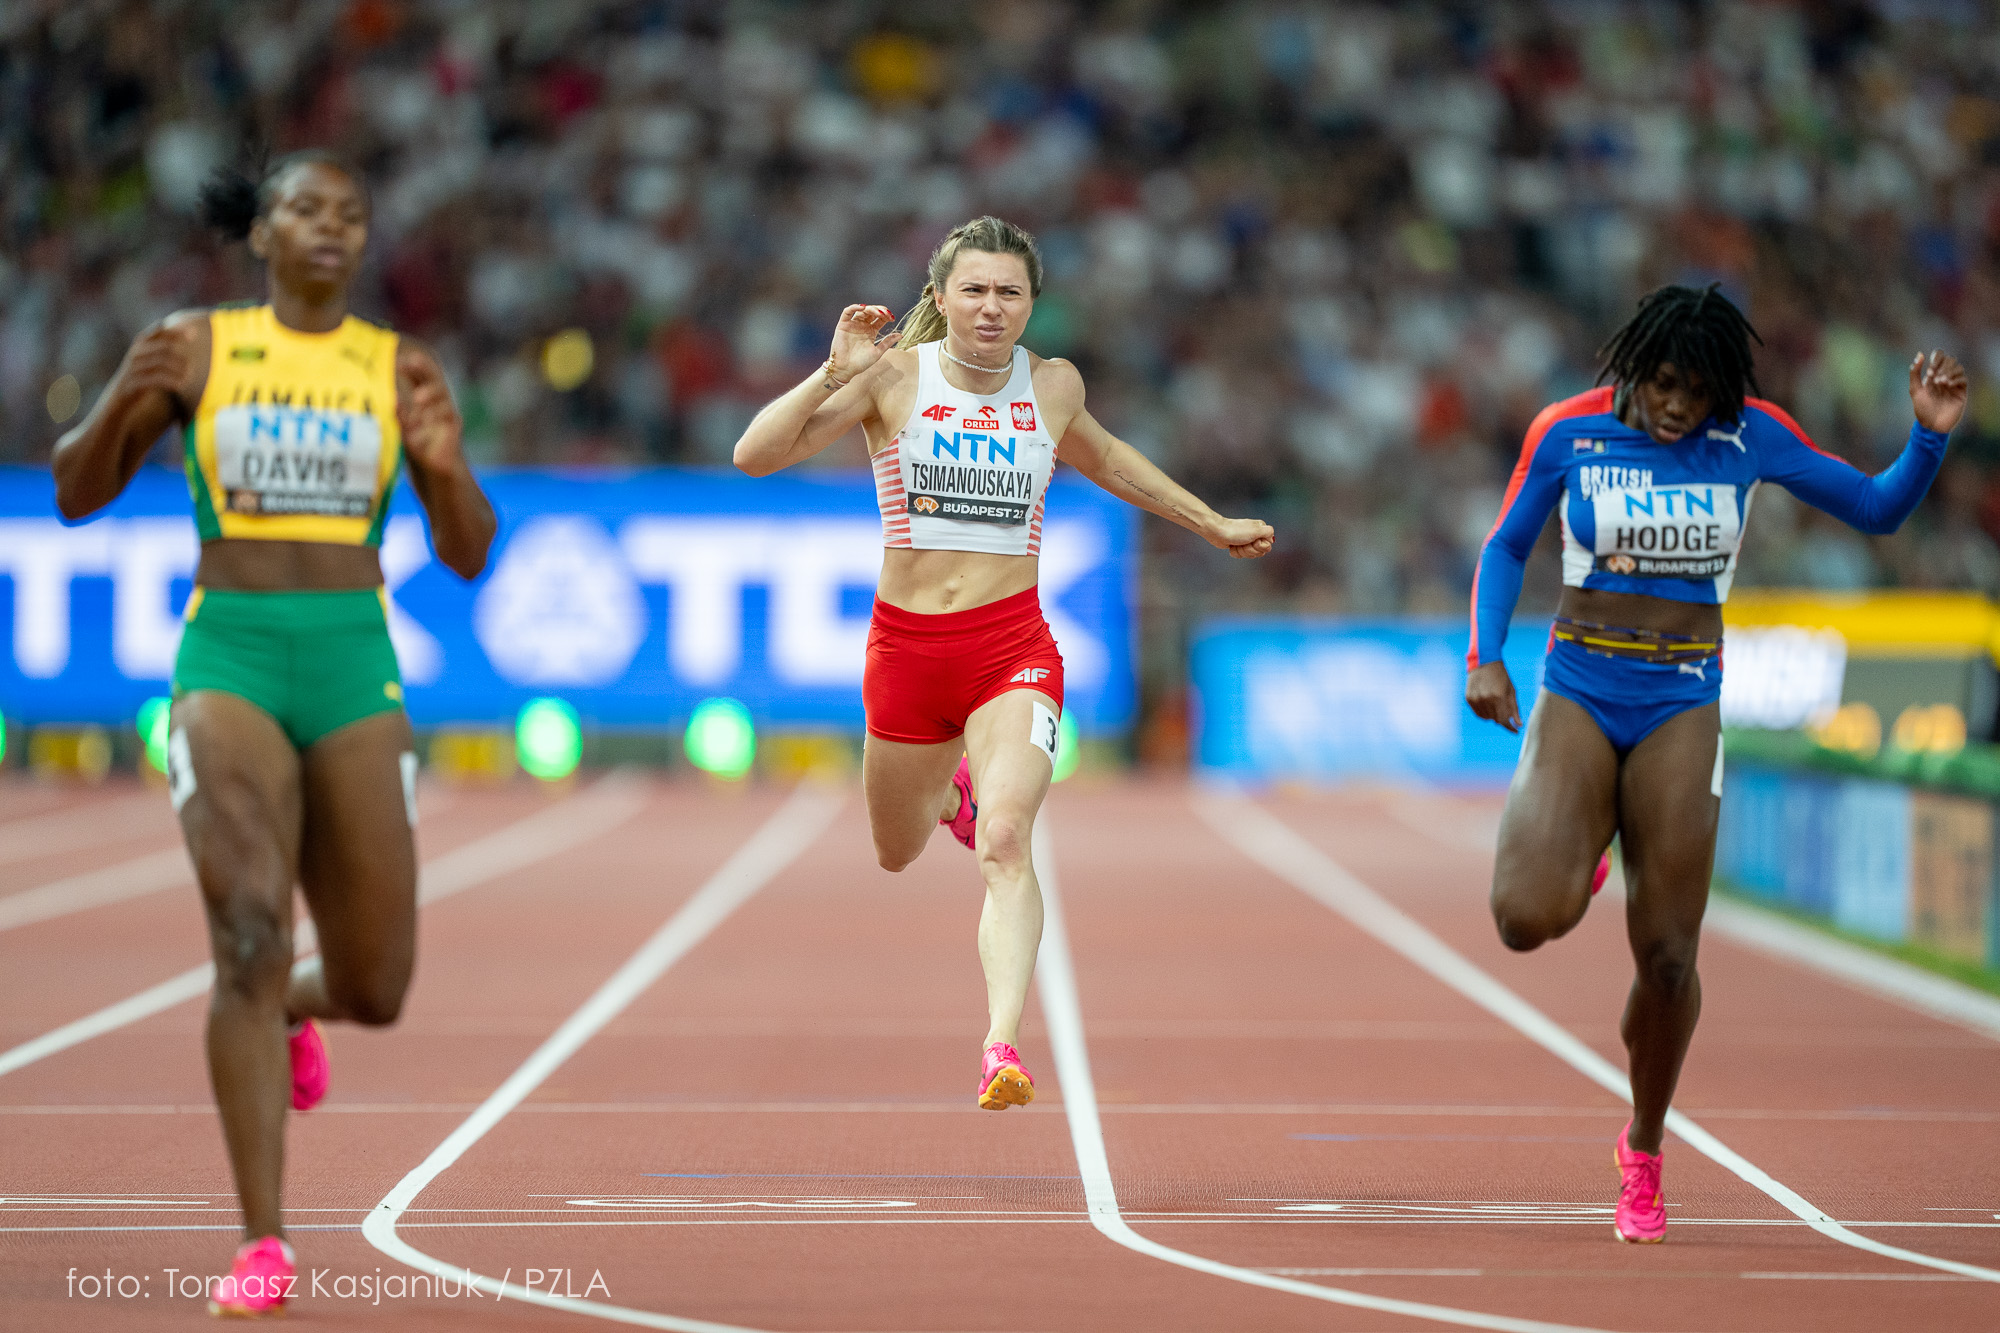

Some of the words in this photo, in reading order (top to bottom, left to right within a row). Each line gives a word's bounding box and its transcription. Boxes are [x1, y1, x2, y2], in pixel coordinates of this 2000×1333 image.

[249, 410, 351, 446] NTN
[964, 420, 998, 430] ORLEN
[932, 430, 1016, 467] NTN
[242, 451, 348, 484] DAVIS
[911, 462, 1032, 500] TSIMANOUSKAYA
[1580, 465, 1653, 489] BRITISH
[942, 502, 1012, 518] BUDAPEST
[1625, 488, 1715, 518] NTN
[1615, 524, 1721, 552] HODGE
[1639, 559, 1713, 575] BUDAPEST
[1045, 716, 1057, 754] 3
